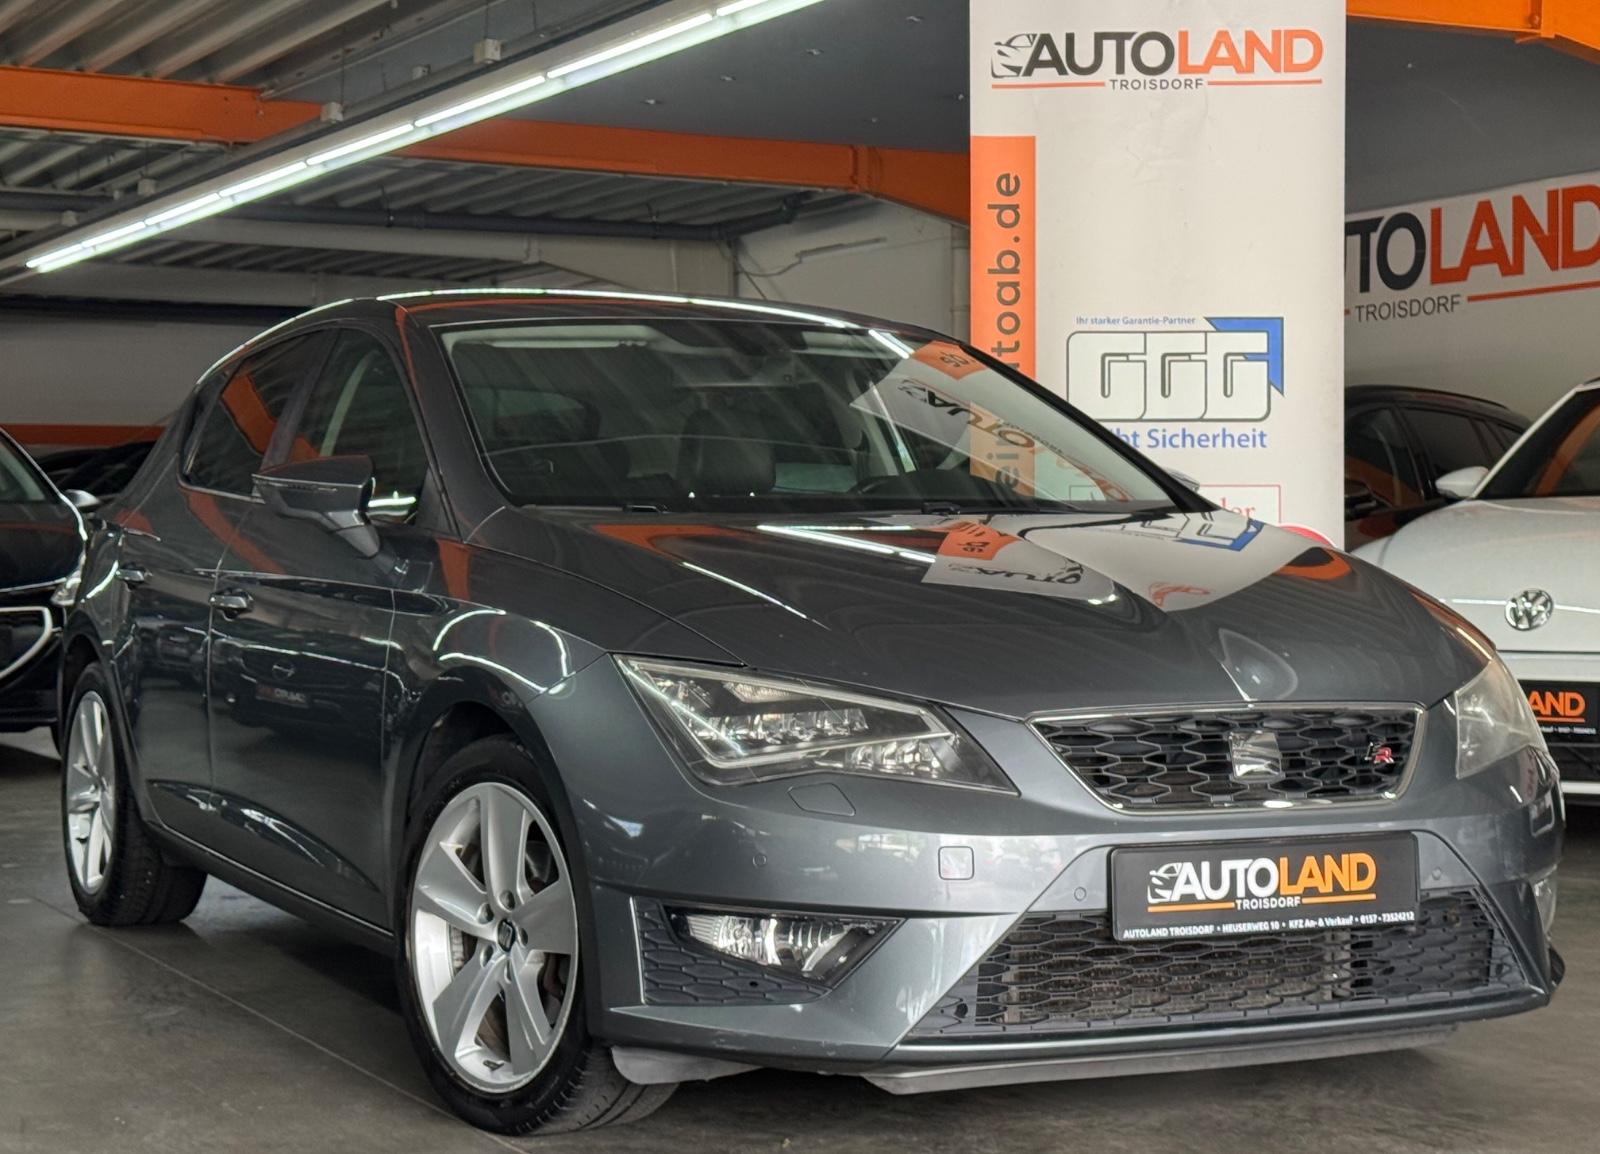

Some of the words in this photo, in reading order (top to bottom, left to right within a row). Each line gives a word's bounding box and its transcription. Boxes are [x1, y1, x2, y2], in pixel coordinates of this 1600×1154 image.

[1022, 29, 1324, 77] AUTOLAND
[1109, 78, 1204, 91] TROISDORF
[1344, 184, 1600, 294] TOLAND
[1355, 294, 1462, 323] TROISDORF
[1076, 316, 1089, 325] Ihr
[1090, 316, 1120, 325] starker
[1122, 316, 1196, 325] Garantie-Partner
[1147, 428, 1268, 449] Sicherheit
[1172, 852, 1377, 902] AUTOLAND
[1235, 896, 1301, 911] TROISDORF
[1123, 927, 1168, 939] AUTOLAND
[1169, 925, 1214, 936] TROISDORF
